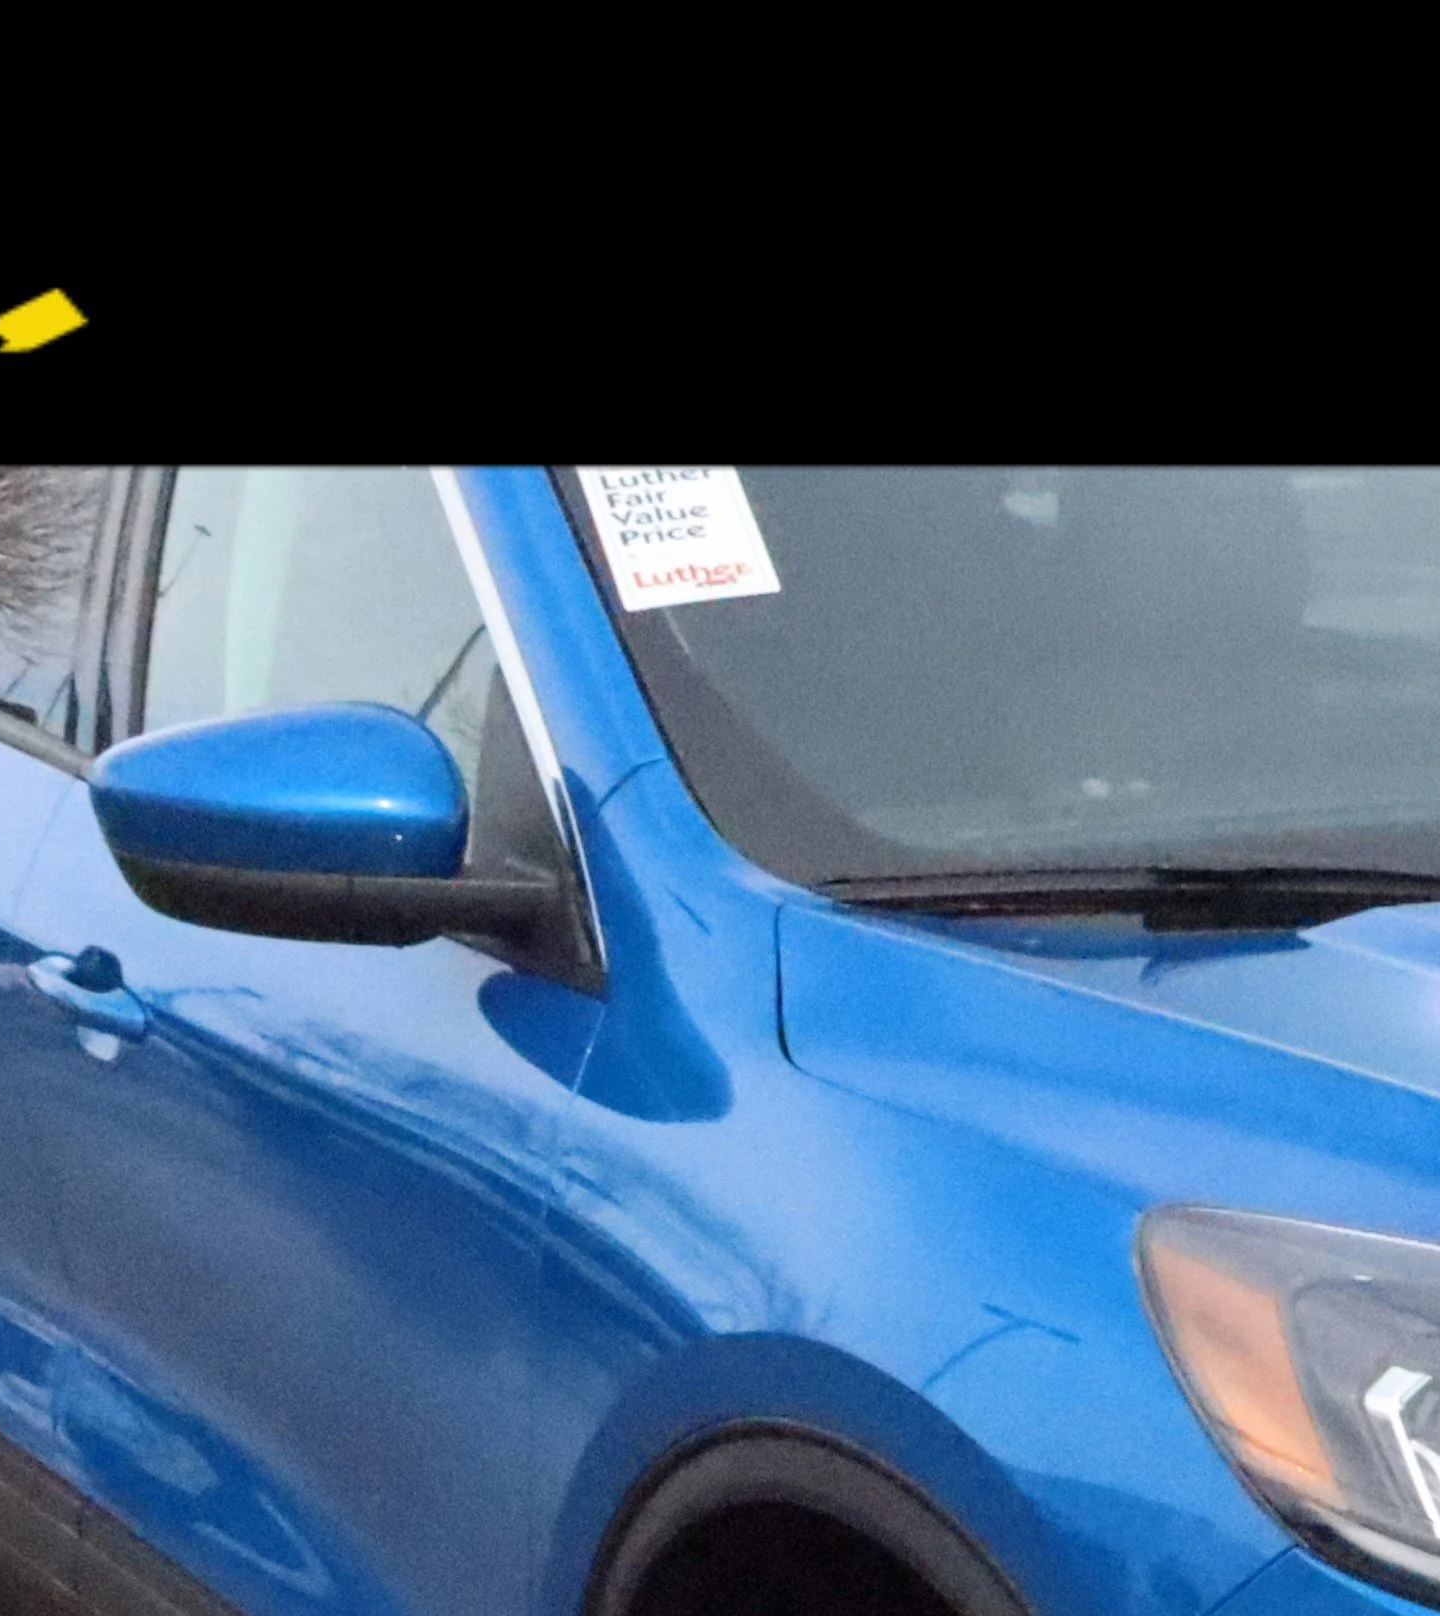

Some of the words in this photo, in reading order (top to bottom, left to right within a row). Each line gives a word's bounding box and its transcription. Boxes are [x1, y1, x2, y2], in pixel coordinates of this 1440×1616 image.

[600, 466, 710, 490] Luther
[607, 490, 666, 510] Fair
[611, 504, 709, 526] Value
[619, 524, 707, 547] Price
[633, 560, 754, 589] Luther
